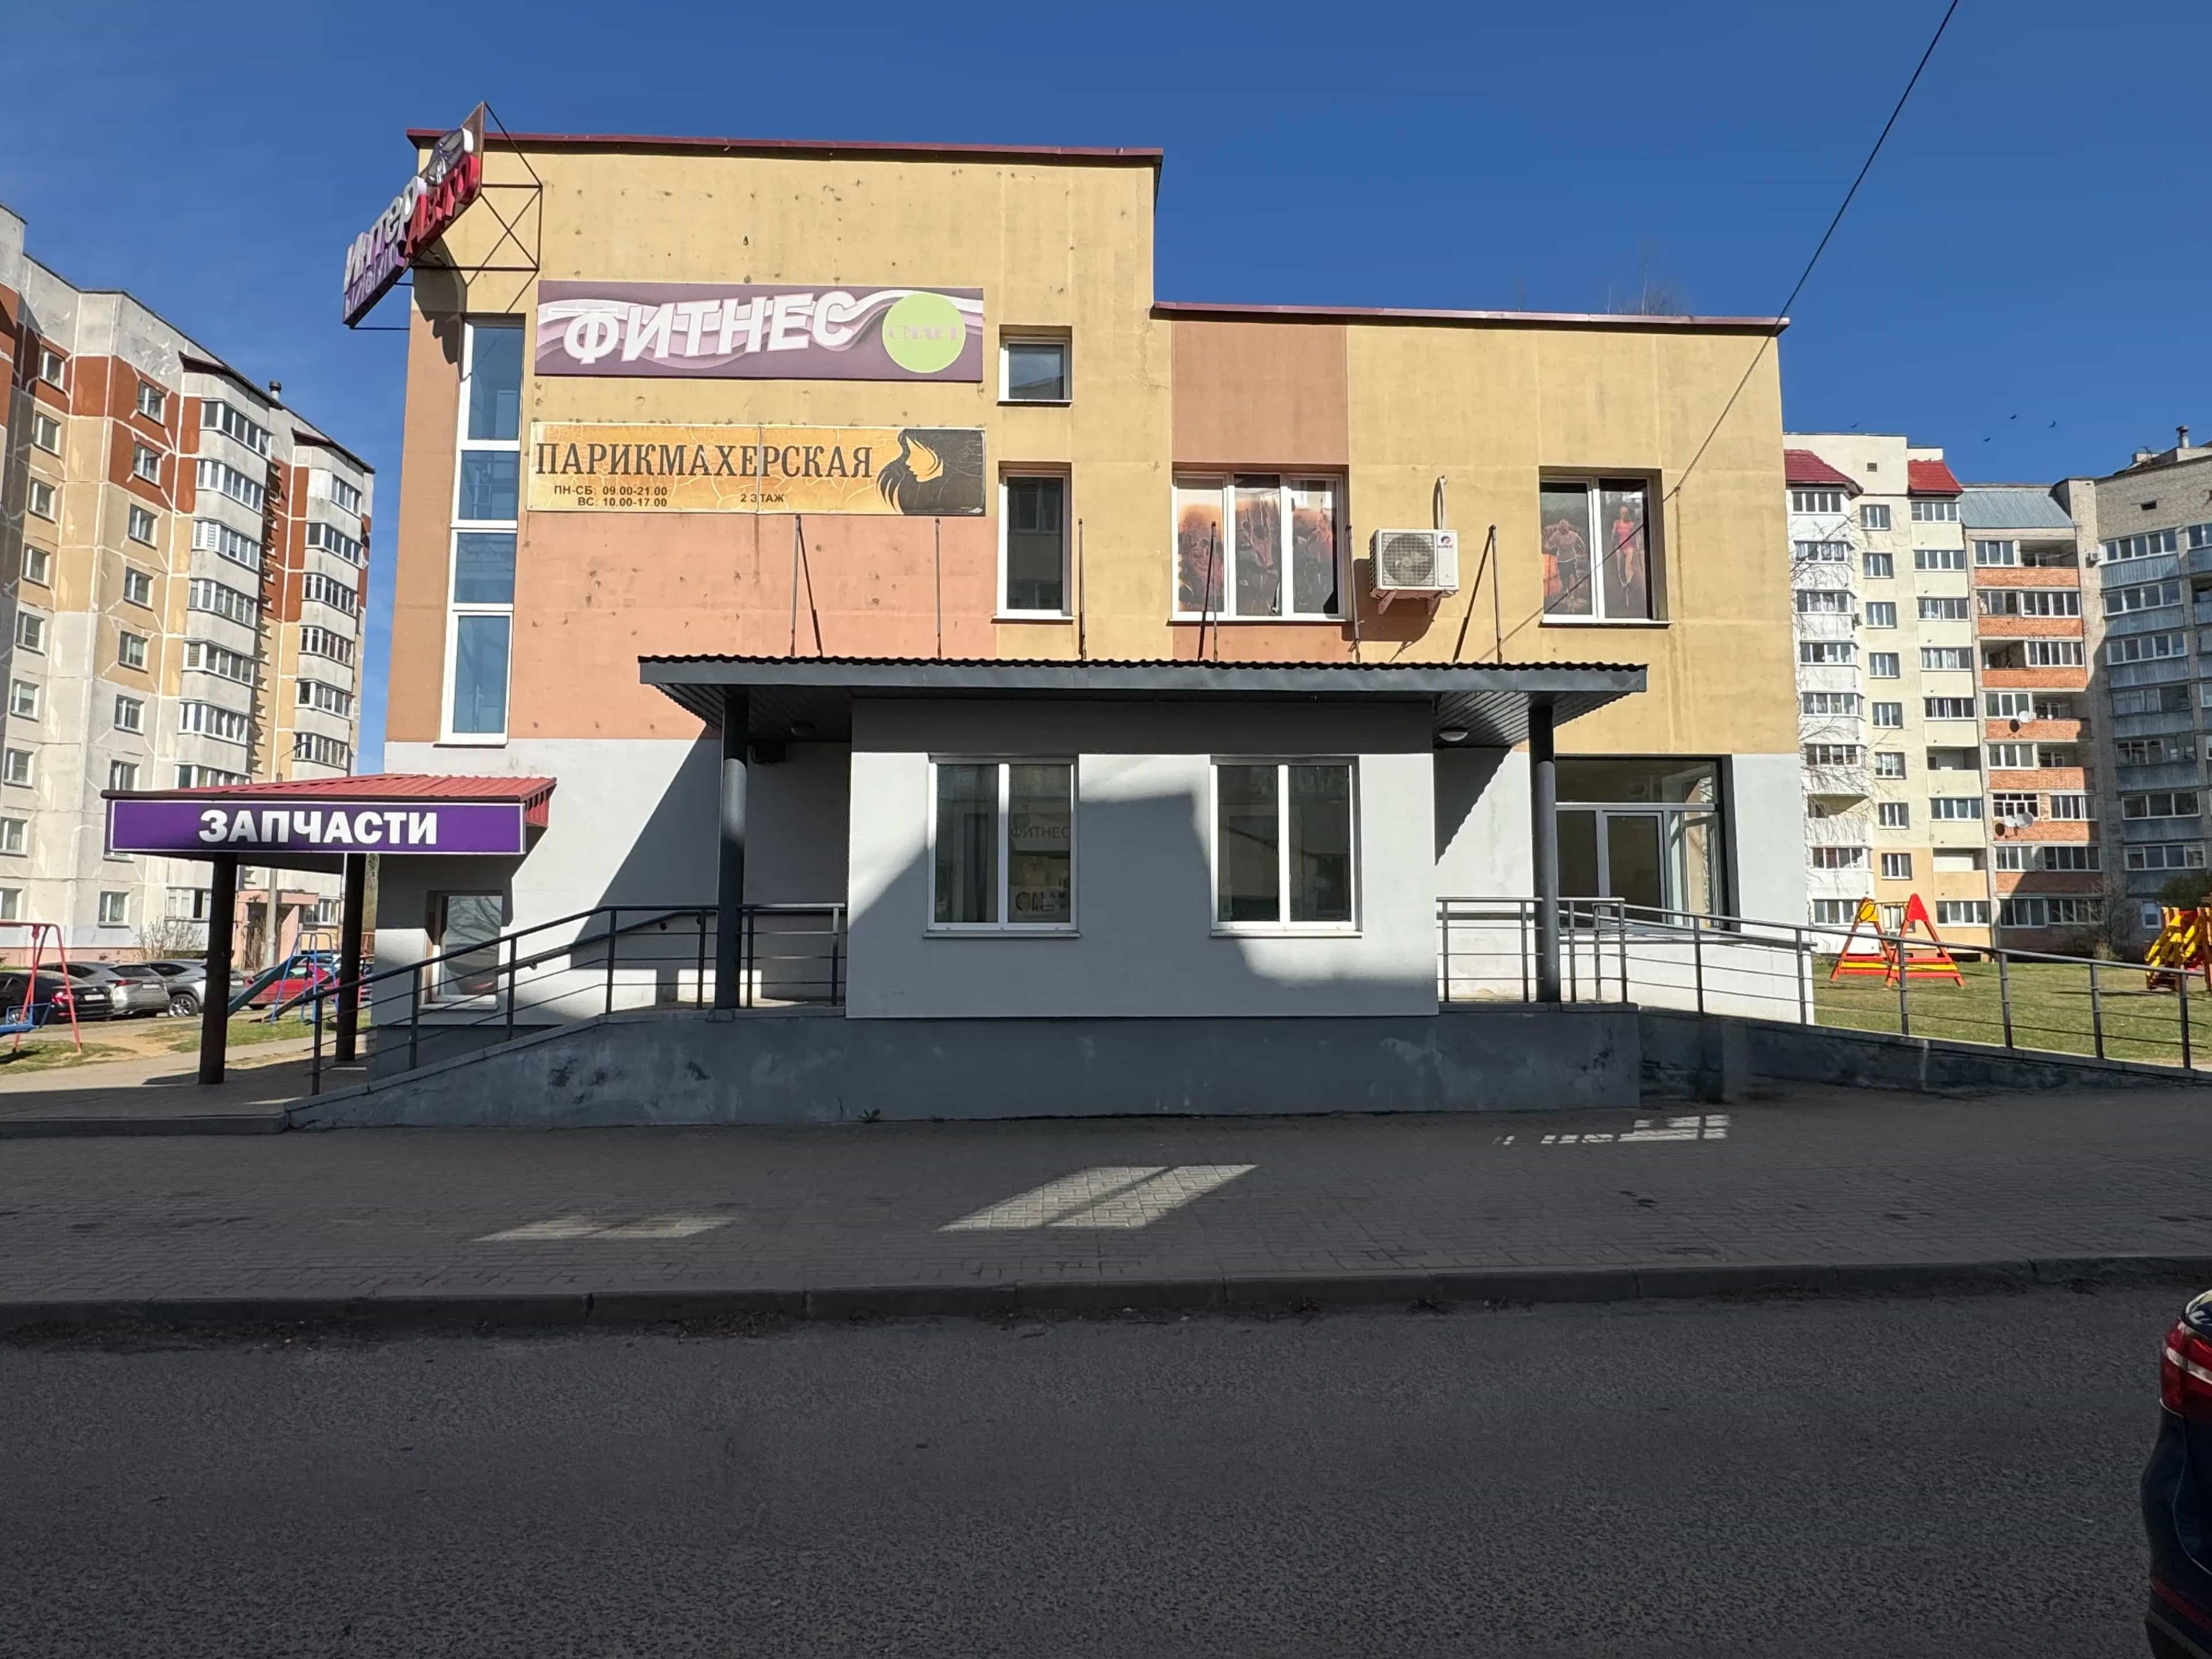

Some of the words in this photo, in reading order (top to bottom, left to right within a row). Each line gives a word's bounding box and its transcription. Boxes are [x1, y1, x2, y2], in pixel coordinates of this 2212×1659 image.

[563, 290, 858, 365] ФИТНЕС
[535, 442, 873, 478] ПАРИКМАХЕРСКАЯ
[603, 486, 668, 496] 09.00-21.00
[740, 494, 747, 502] 2
[750, 494, 785, 502] ЭТАЖ
[603, 497, 668, 507] 10.00-17.00
[199, 809, 437, 845] ЗАПЧАСТИ
[1010, 824, 1070, 839] ФИТНЕС
